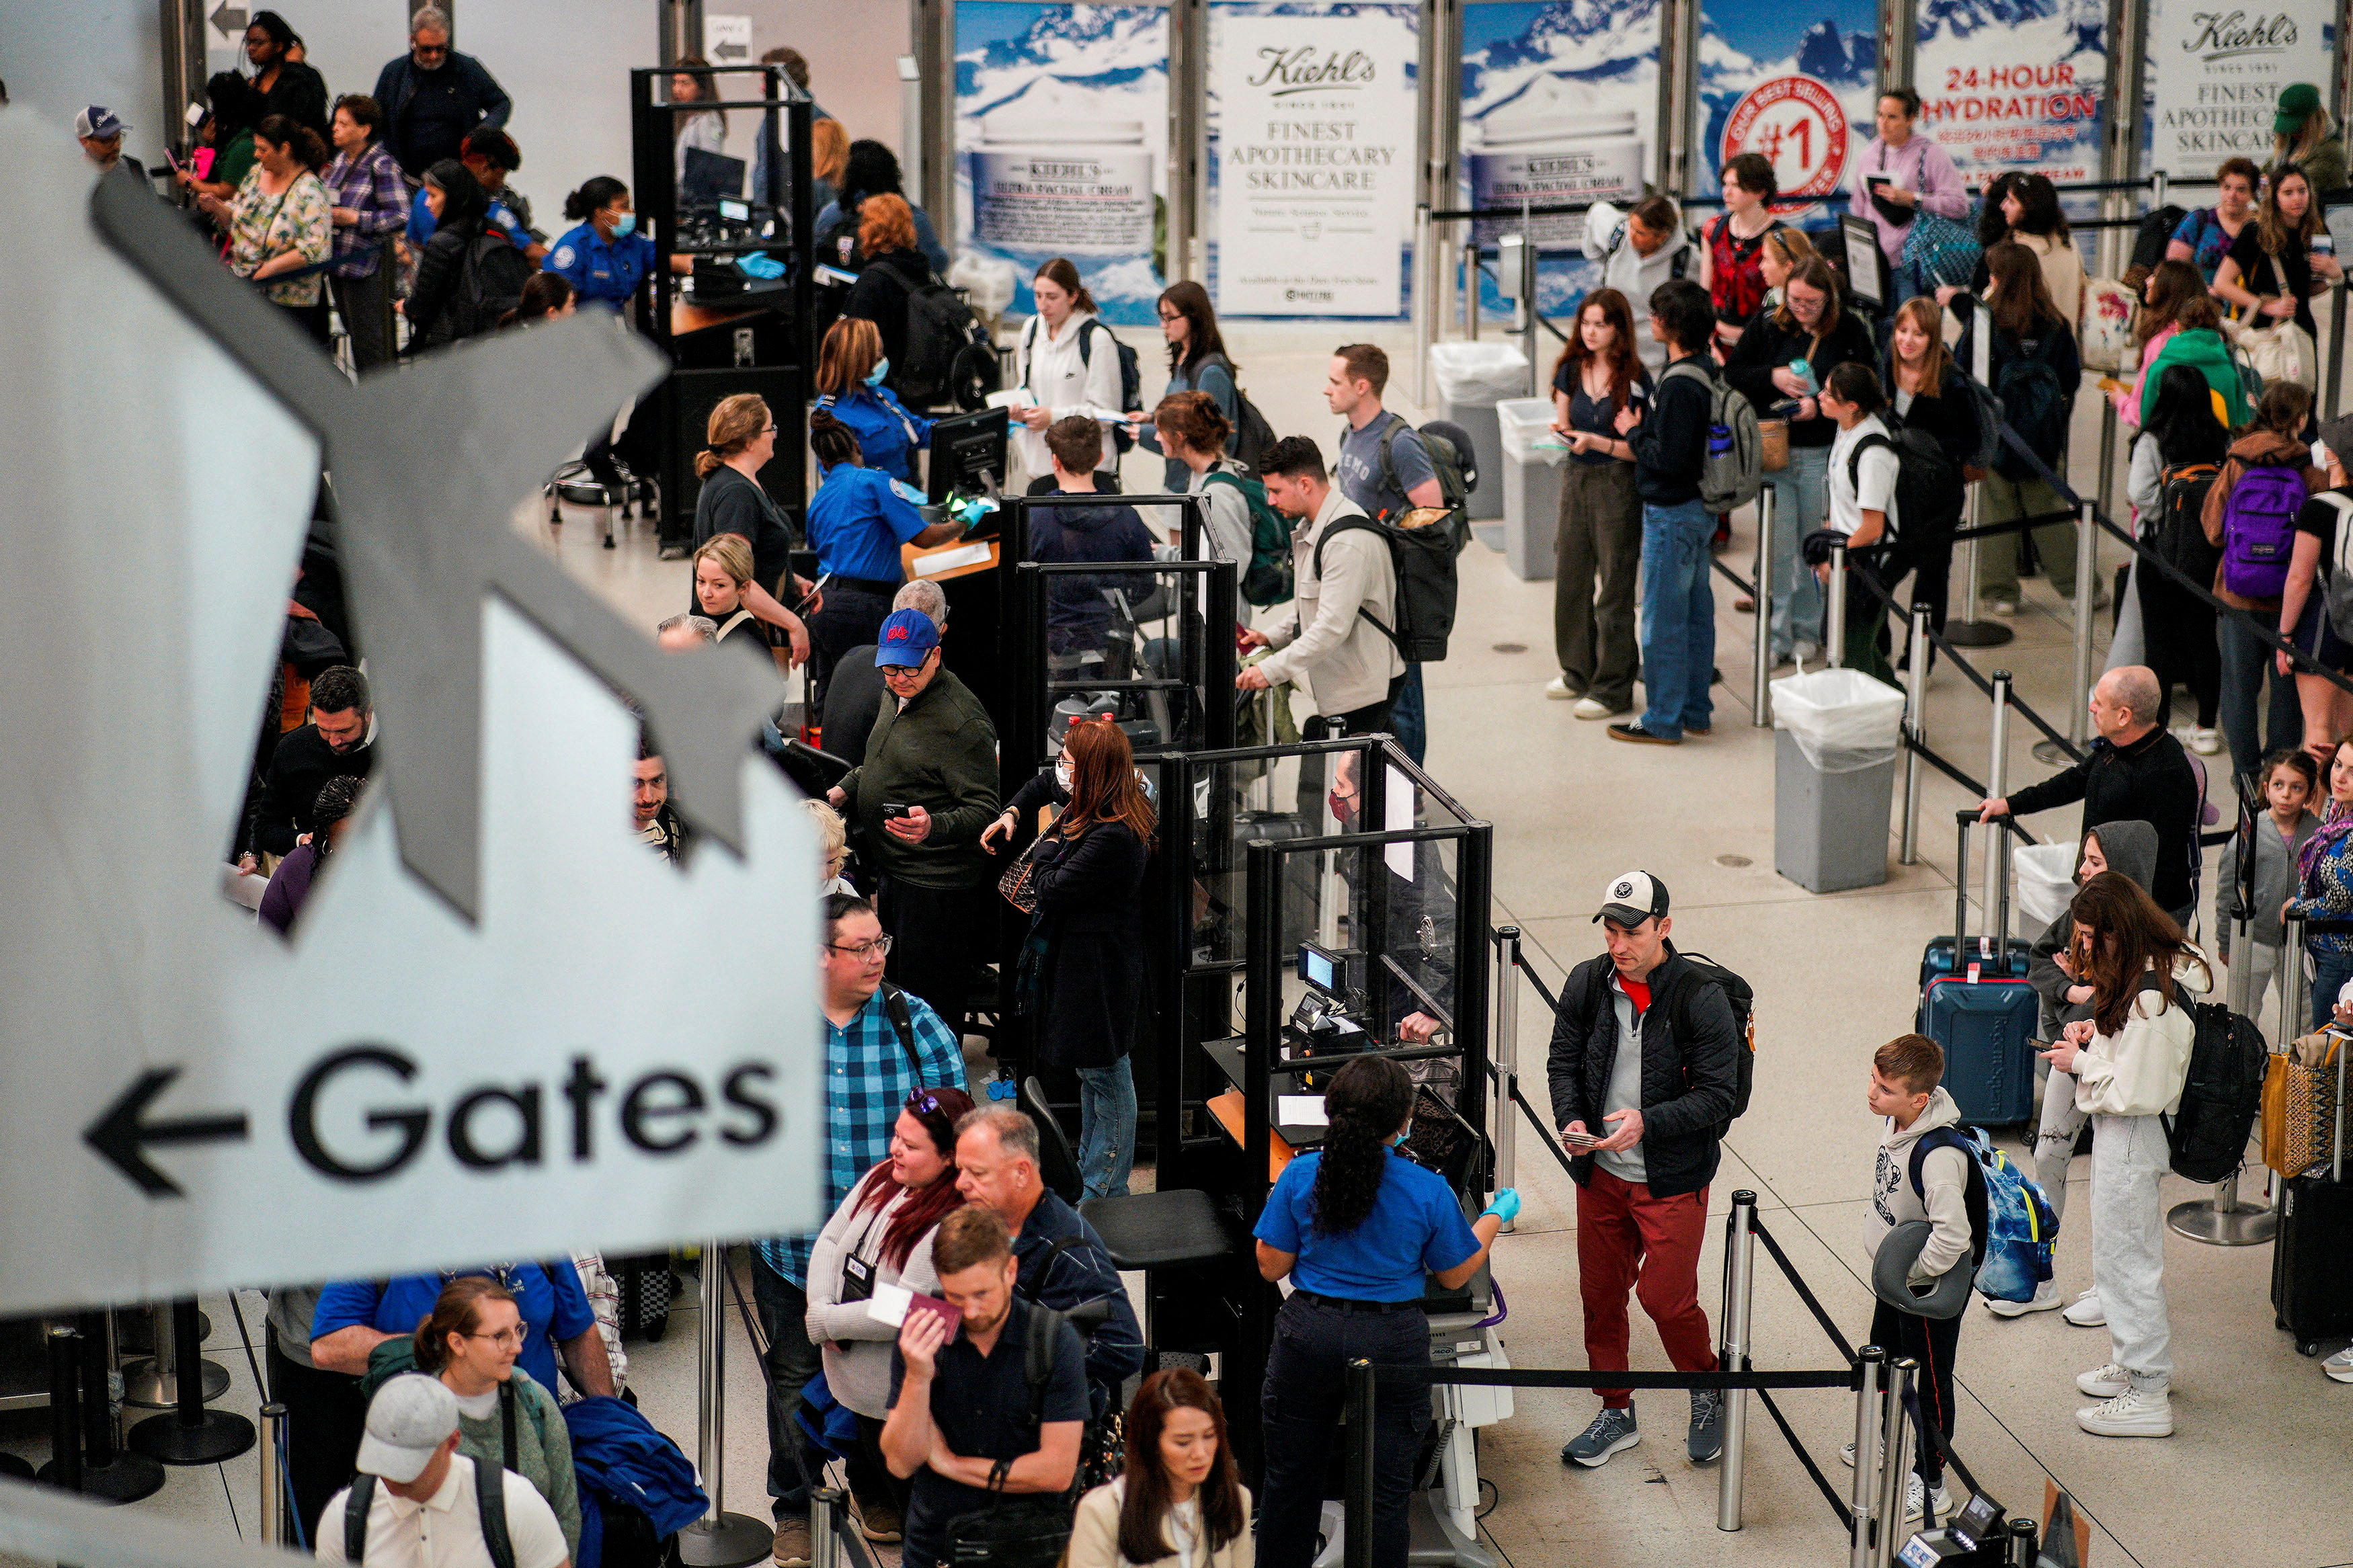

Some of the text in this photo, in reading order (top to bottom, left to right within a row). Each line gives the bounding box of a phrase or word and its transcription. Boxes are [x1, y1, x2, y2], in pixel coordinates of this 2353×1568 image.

[2181, 9, 2298, 52] Kiehl's
[1247, 46, 1375, 87] Kiehl's
[1946, 62, 2075, 92] 24-HOUR
[1921, 93, 2096, 123] HYDRATION
[2198, 83, 2279, 104] FINEST
[1730, 81, 1843, 141] OUR BEST SELLING
[1267, 122, 1357, 140] FINEST
[1756, 117, 1810, 169] #1
[2177, 130, 2277, 152] SKINCAR
[1228, 146, 1397, 166] APOTHECARY
[1246, 170, 1376, 190] SKINCARE
[1343, 452, 1370, 481] EMO
[287, 1040, 783, 1185] Gates
